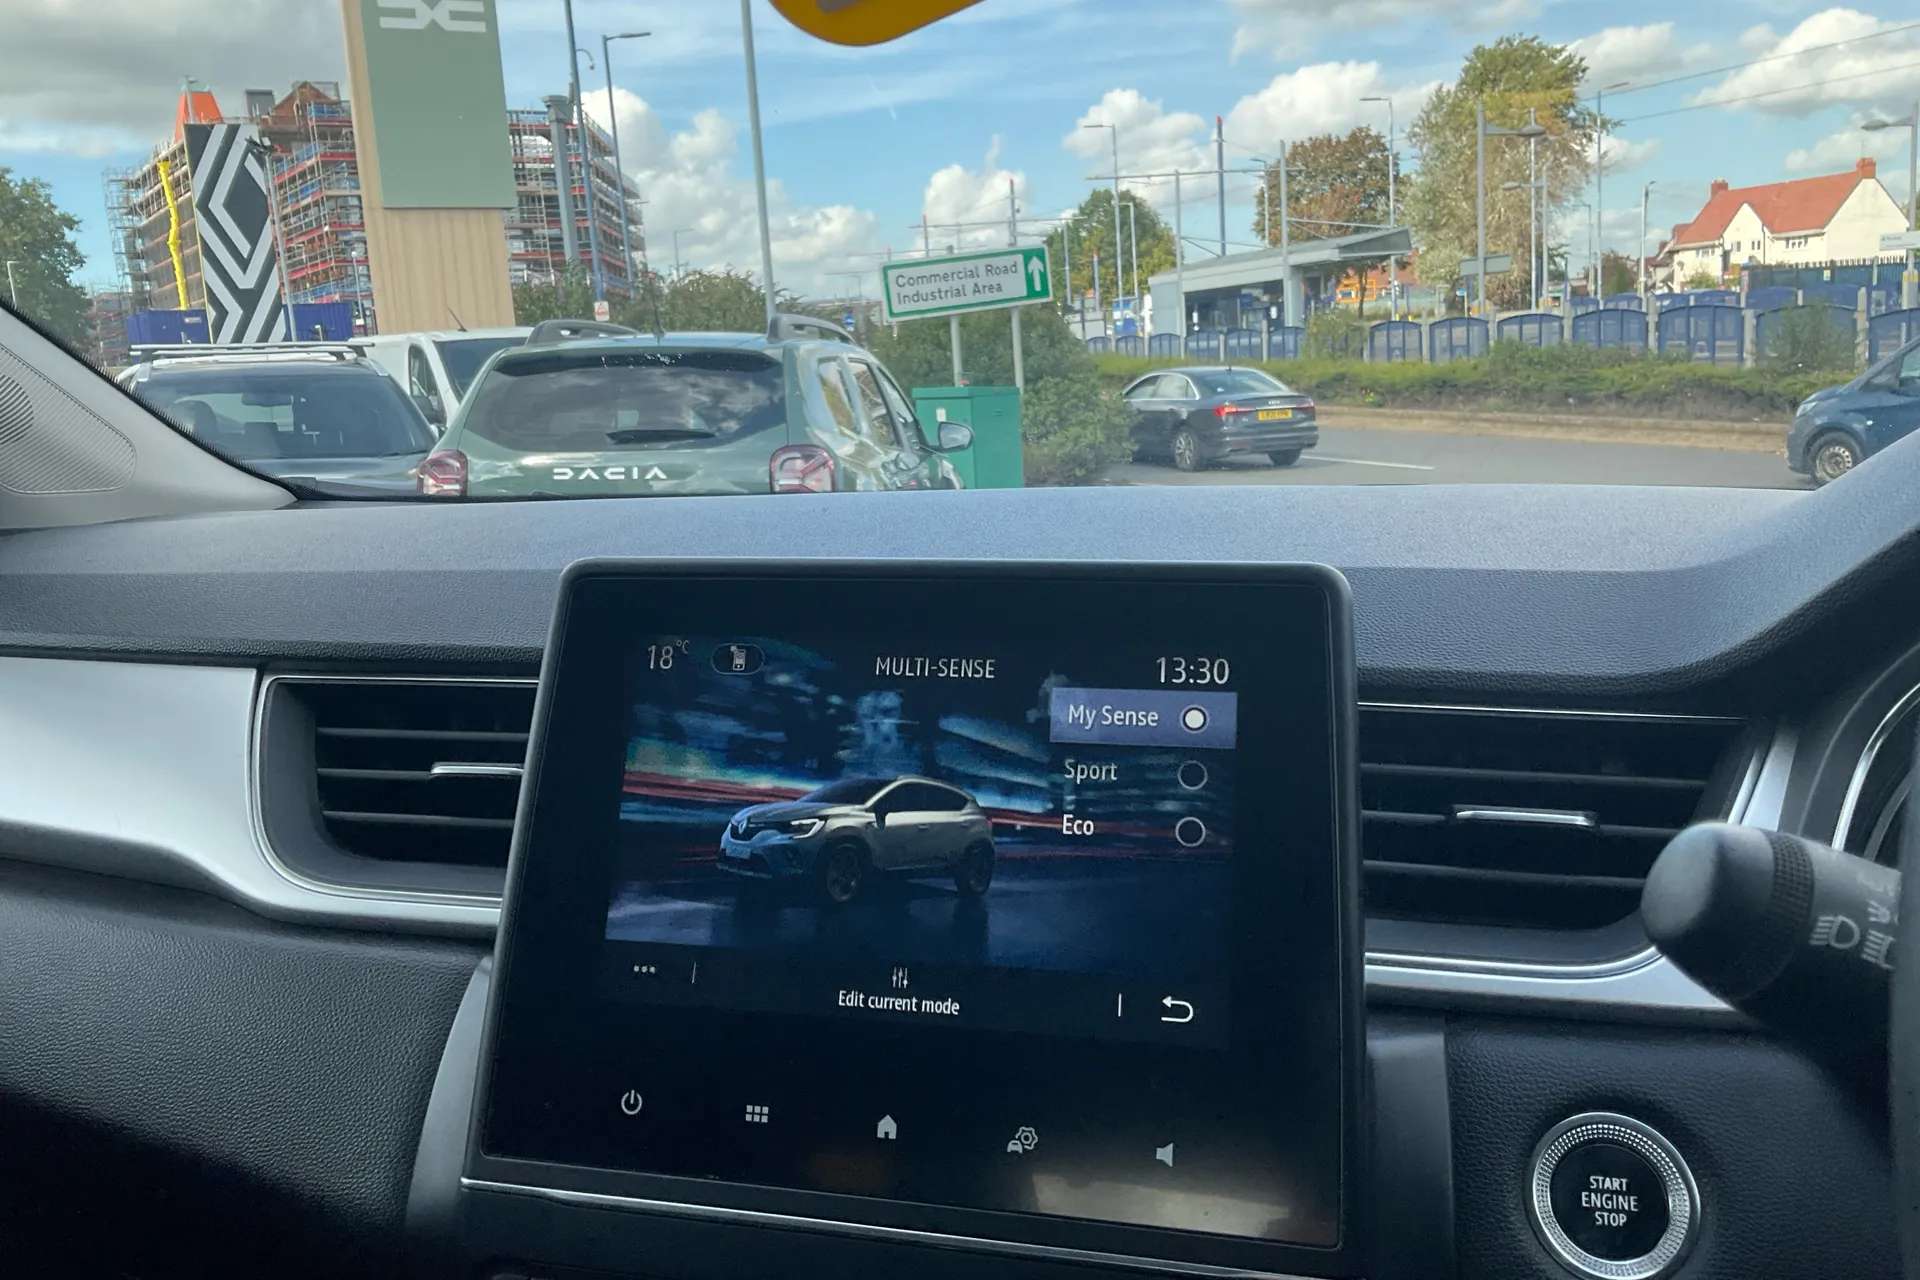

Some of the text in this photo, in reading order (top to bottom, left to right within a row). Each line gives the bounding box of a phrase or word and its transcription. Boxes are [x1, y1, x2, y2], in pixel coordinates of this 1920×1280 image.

[896, 261, 1018, 288] Commercial Road
[897, 281, 1003, 305] Industrial Area
[553, 466, 668, 480] DACIA
[875, 656, 996, 679] MULTI-SENSE
[1156, 656, 1230, 685] 13:30
[1068, 703, 1159, 730] My Sense
[1063, 758, 1118, 785] Sport
[1062, 813, 1095, 836] Eco
[838, 990, 960, 1016] Edit current mode
[1589, 1175, 1628, 1192] START
[1581, 1191, 1639, 1212] ENGINE
[1594, 1211, 1628, 1227] STOP
